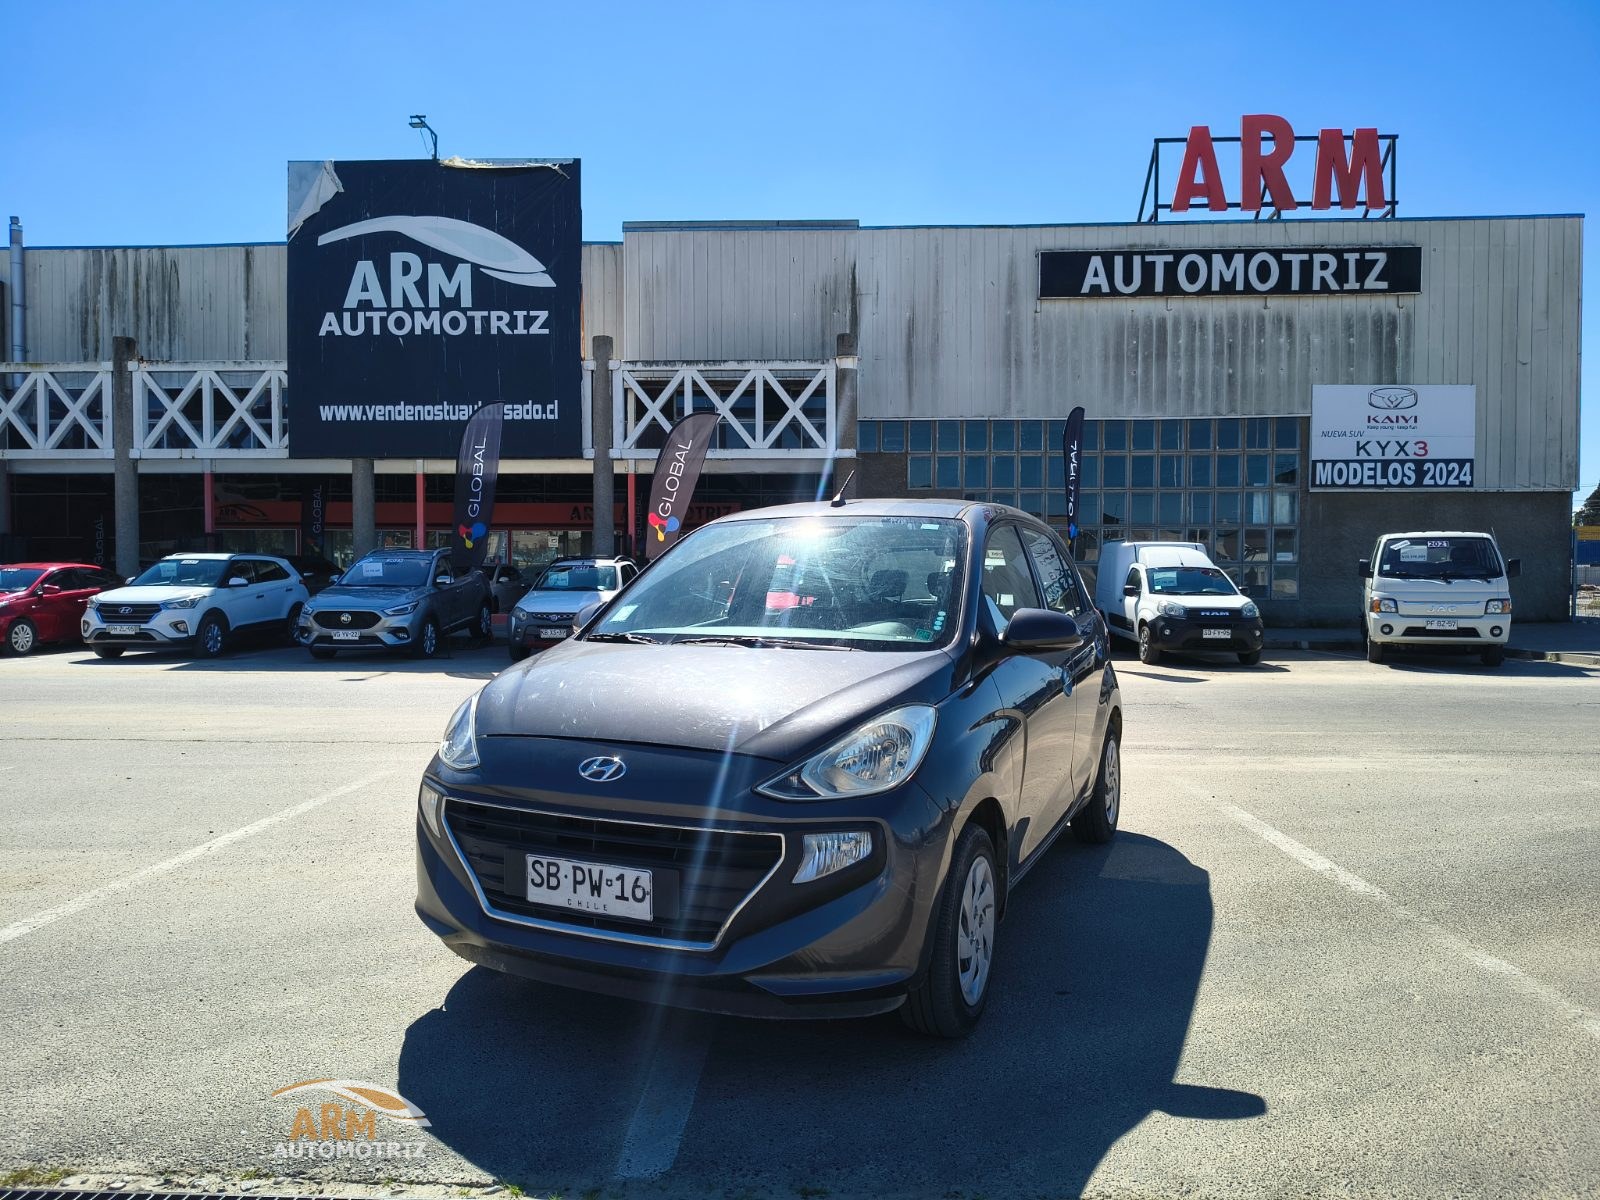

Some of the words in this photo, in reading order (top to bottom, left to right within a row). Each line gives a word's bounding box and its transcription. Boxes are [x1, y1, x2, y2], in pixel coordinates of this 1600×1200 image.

[1170, 114, 1386, 212] ARM
[343, 252, 473, 308] ARM
[1080, 252, 1389, 295] AUTOMOTRIZ
[318, 310, 550, 337] AUTOMOTRIZ
[1321, 430, 1348, 438] NUEVA
[1348, 430, 1365, 438] SUV
[1367, 415, 1418, 424] KAIYI
[1356, 440, 1429, 457] KYX3
[468, 436, 488, 518] GLOBAL
[658, 438, 693, 518] GLOBAL
[1315, 462, 1416, 485] MODELOS
[1423, 462, 1472, 485] 2024
[311, 484, 323, 534] GLOBAL
[567, 898, 608, 912] CHILE
